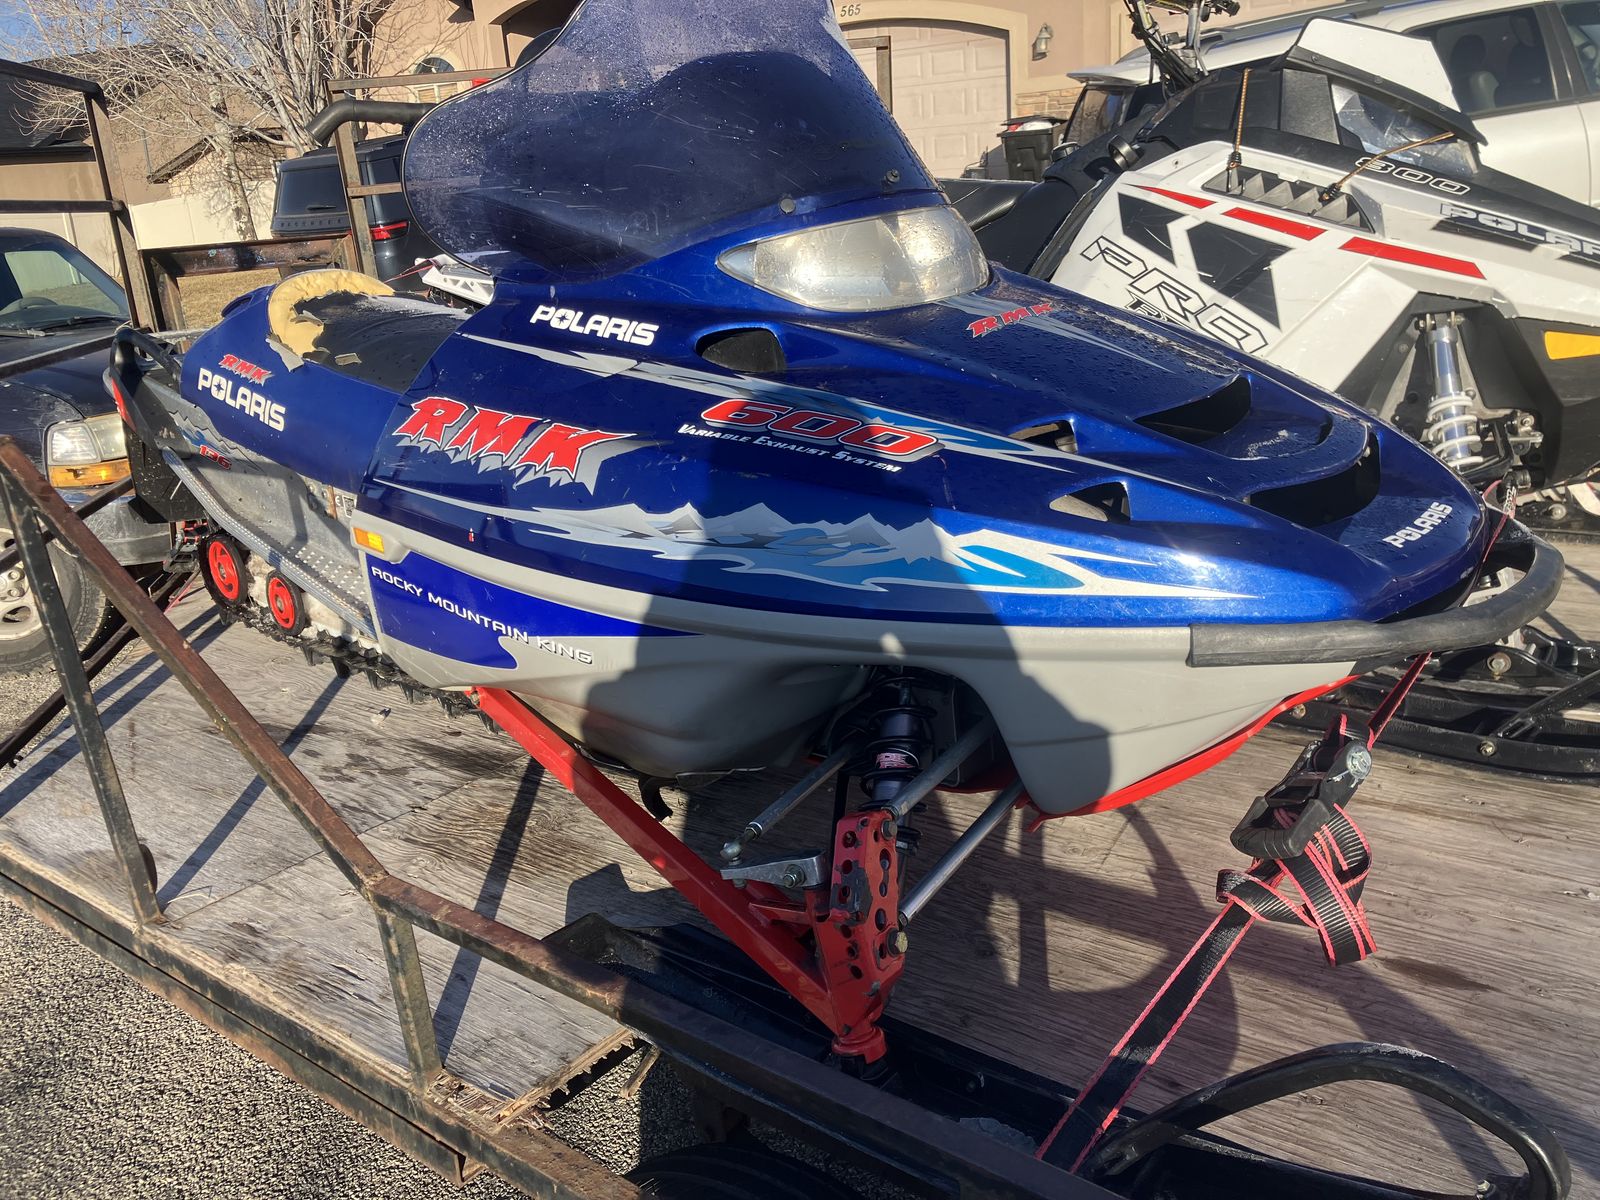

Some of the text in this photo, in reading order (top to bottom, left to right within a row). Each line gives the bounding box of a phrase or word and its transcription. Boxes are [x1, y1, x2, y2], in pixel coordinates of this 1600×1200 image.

[840, 4, 861, 17] 565
[1355, 157, 1471, 195] 800
[1080, 235, 1269, 354] PRO
[529, 305, 659, 346] POLARIS
[965, 303, 1054, 338] RMK
[219, 354, 272, 383] RMK
[198, 367, 286, 431] POLARIS
[391, 396, 637, 479] RMK
[677, 423, 902, 473] VARIABLE EXHAUST SYSTEM
[700, 399, 939, 456] 600
[1382, 501, 1453, 548] POLARIS
[371, 565, 594, 665] ROCKY MOUNTAIN KING
